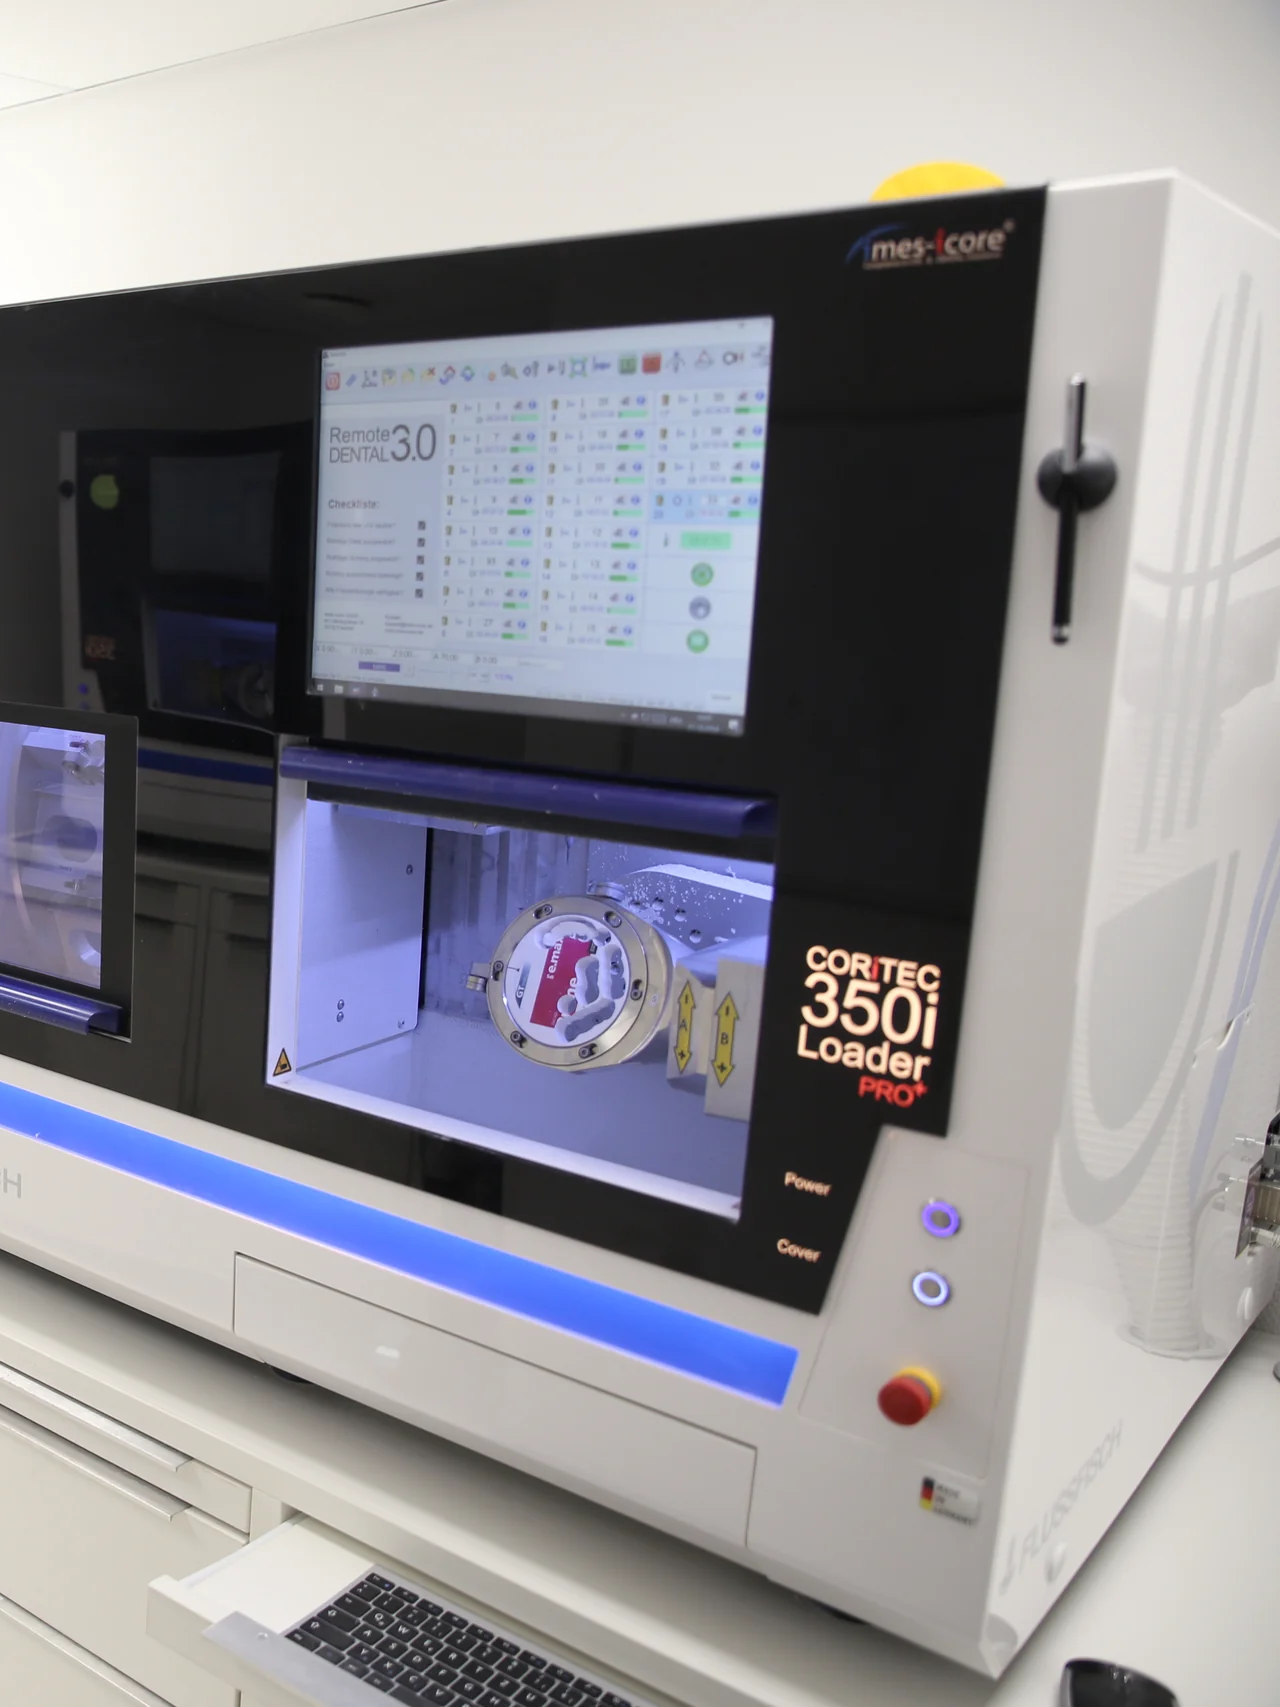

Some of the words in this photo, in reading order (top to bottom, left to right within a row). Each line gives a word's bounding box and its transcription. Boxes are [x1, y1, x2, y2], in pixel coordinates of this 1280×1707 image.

[329, 426, 390, 444] Remote
[391, 423, 436, 462] 3.0
[329, 446, 389, 463] DENTAL
[328, 499, 380, 510] Checkliste:
[801, 971, 939, 1050] 350i
[680, 1019, 688, 1032] A
[720, 1032, 729, 1045] B
[797, 1023, 932, 1082] Loader
[784, 1171, 832, 1197] Power
[777, 1238, 822, 1263] Cover
